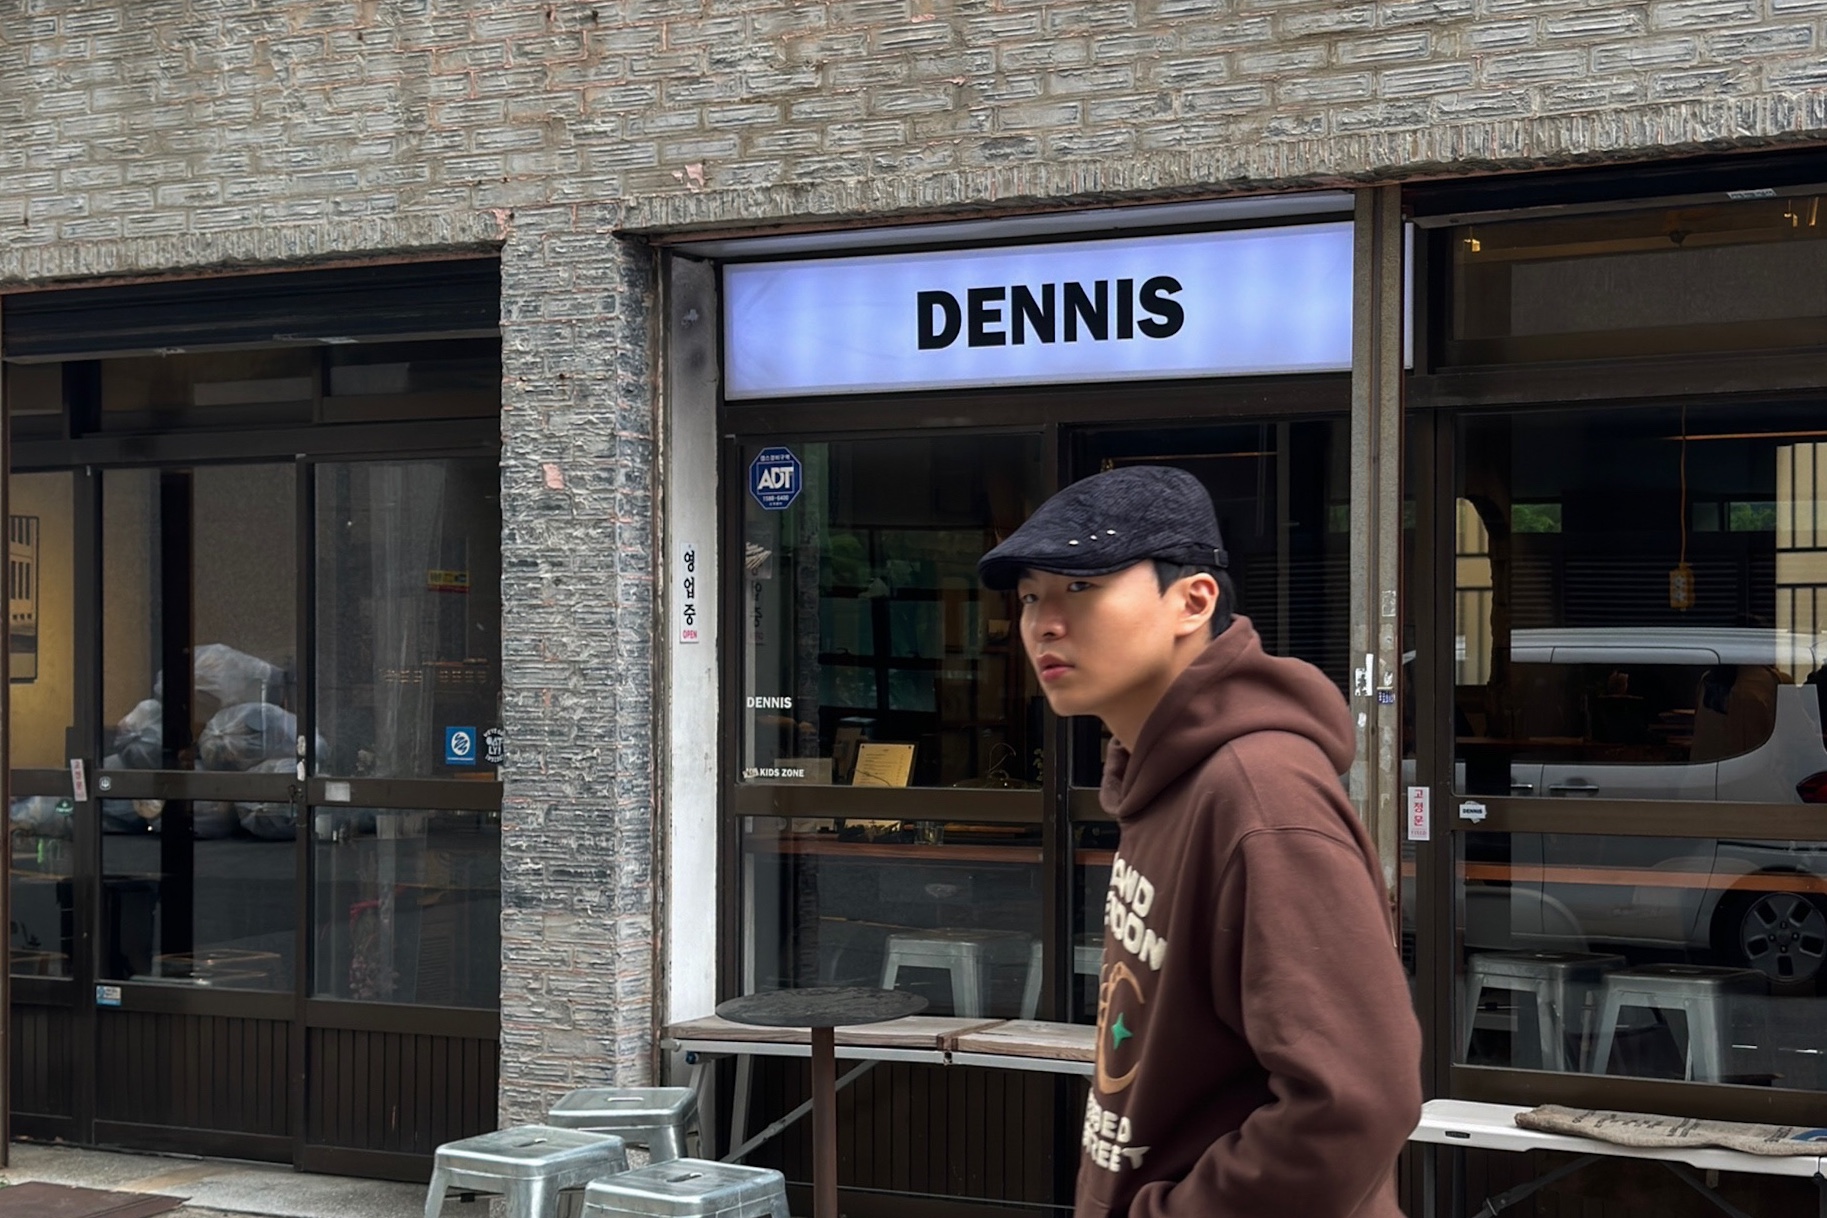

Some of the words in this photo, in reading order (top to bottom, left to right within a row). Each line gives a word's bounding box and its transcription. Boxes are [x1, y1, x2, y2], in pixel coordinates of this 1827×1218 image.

[917, 276, 1184, 350] DENNIS
[757, 466, 794, 489] ADT
[683, 550, 696, 626] 영업중
[682, 629, 698, 639] OPEN
[746, 696, 792, 709] DENNIS
[760, 767, 780, 777] KIDS
[781, 767, 805, 778] ZONE
[1414, 789, 1424, 827] 고정문
[1110, 851, 1155, 918] AND
